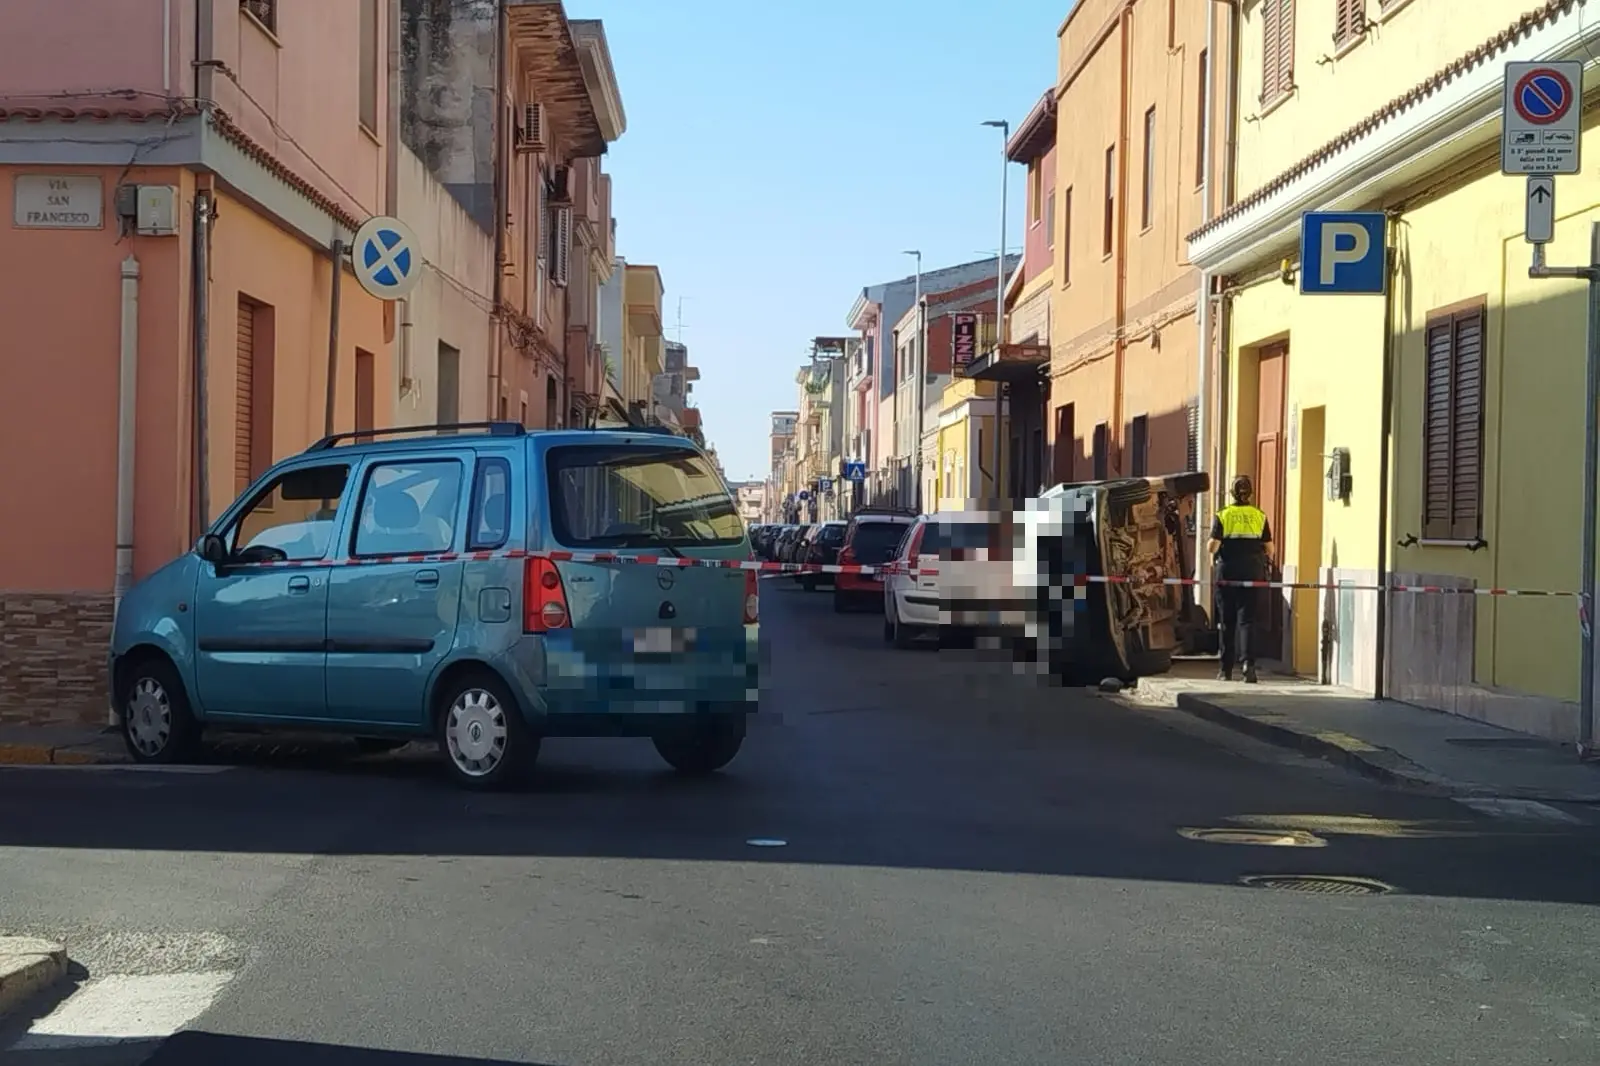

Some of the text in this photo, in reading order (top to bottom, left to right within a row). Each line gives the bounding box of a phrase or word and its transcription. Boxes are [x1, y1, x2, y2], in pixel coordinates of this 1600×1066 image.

[48, 180, 69, 190] VIA
[47, 196, 70, 206] SAN
[27, 212, 90, 223] FRANCESCO
[1320, 222, 1370, 285] P
